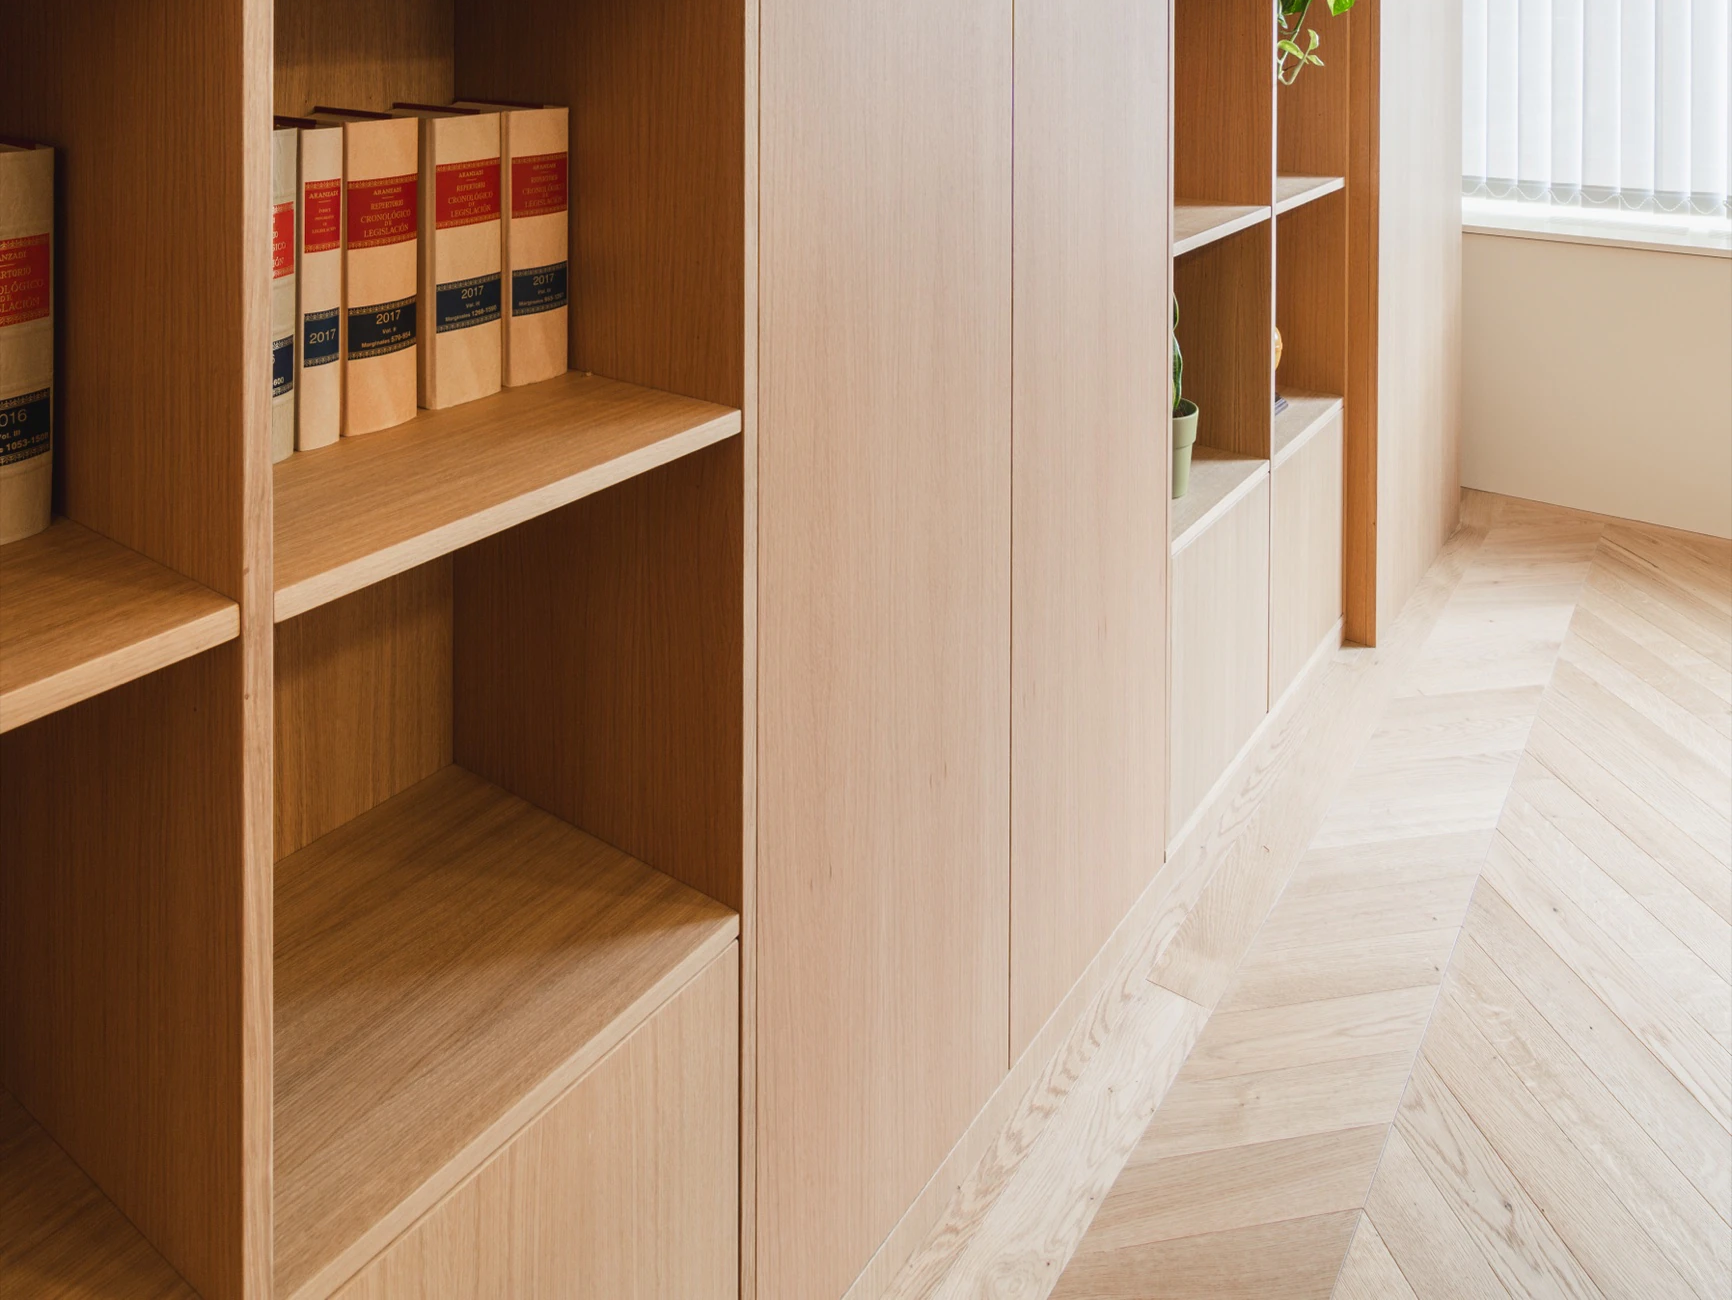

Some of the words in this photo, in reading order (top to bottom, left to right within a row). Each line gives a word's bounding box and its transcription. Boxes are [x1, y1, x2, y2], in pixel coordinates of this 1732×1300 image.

[360, 209, 411, 224] CRONOLÓGICO
[363, 223, 409, 238] LEGISLACIÓN
[0, 251, 26, 263] NZADI
[0, 267, 31, 280] RTORIO
[533, 273, 554, 286] 2017
[461, 285, 484, 299] 2017
[375, 310, 401, 325] 2017
[309, 328, 336, 344] 2017
